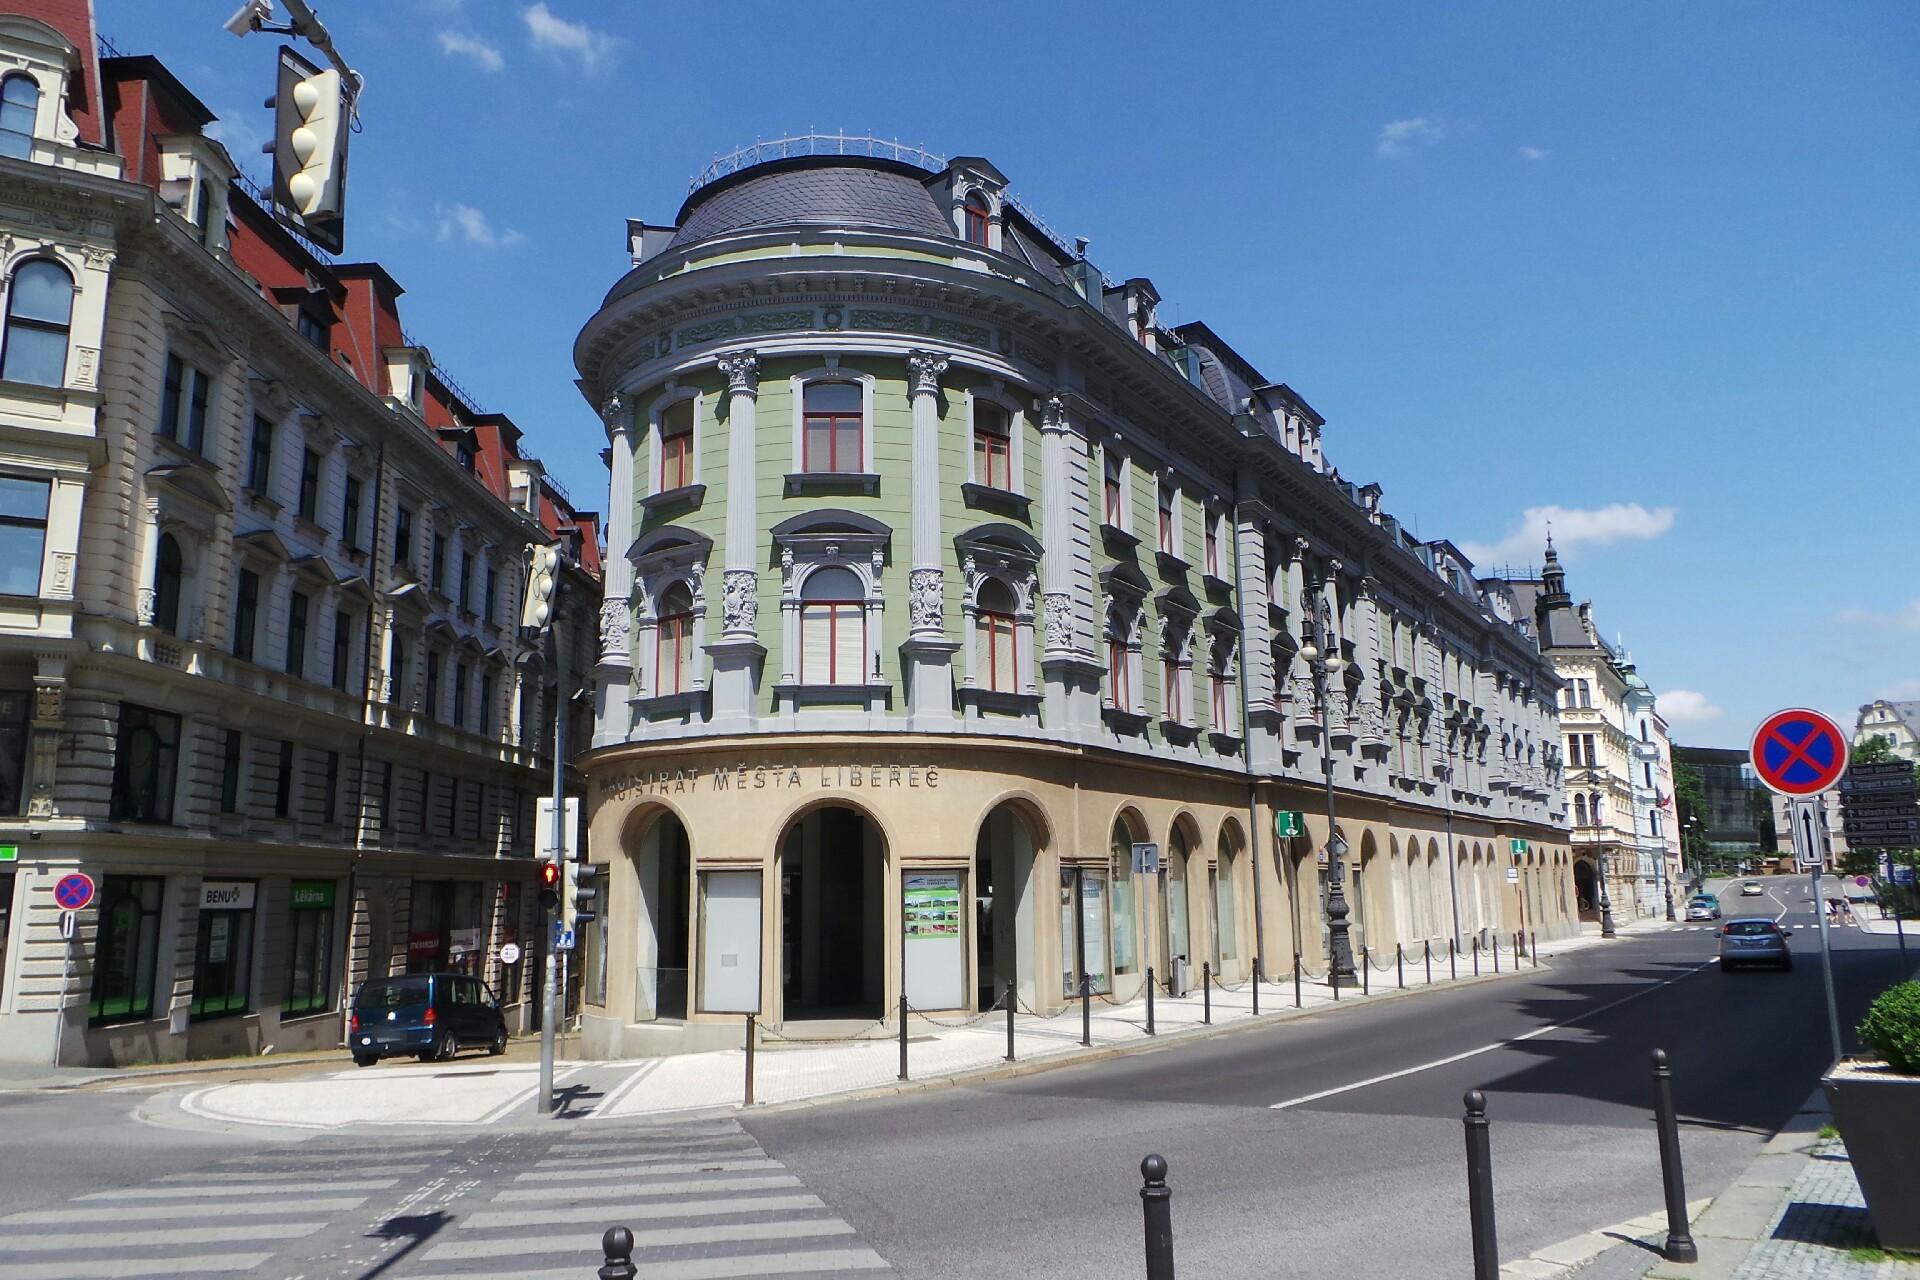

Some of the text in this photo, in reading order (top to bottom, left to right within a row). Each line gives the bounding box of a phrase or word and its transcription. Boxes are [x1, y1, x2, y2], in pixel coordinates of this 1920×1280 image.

[714, 763, 801, 784] MĚSTA
[820, 764, 938, 784] LIBEREC
[206, 890, 231, 903] BENU
[295, 889, 325, 902] Lékárna
